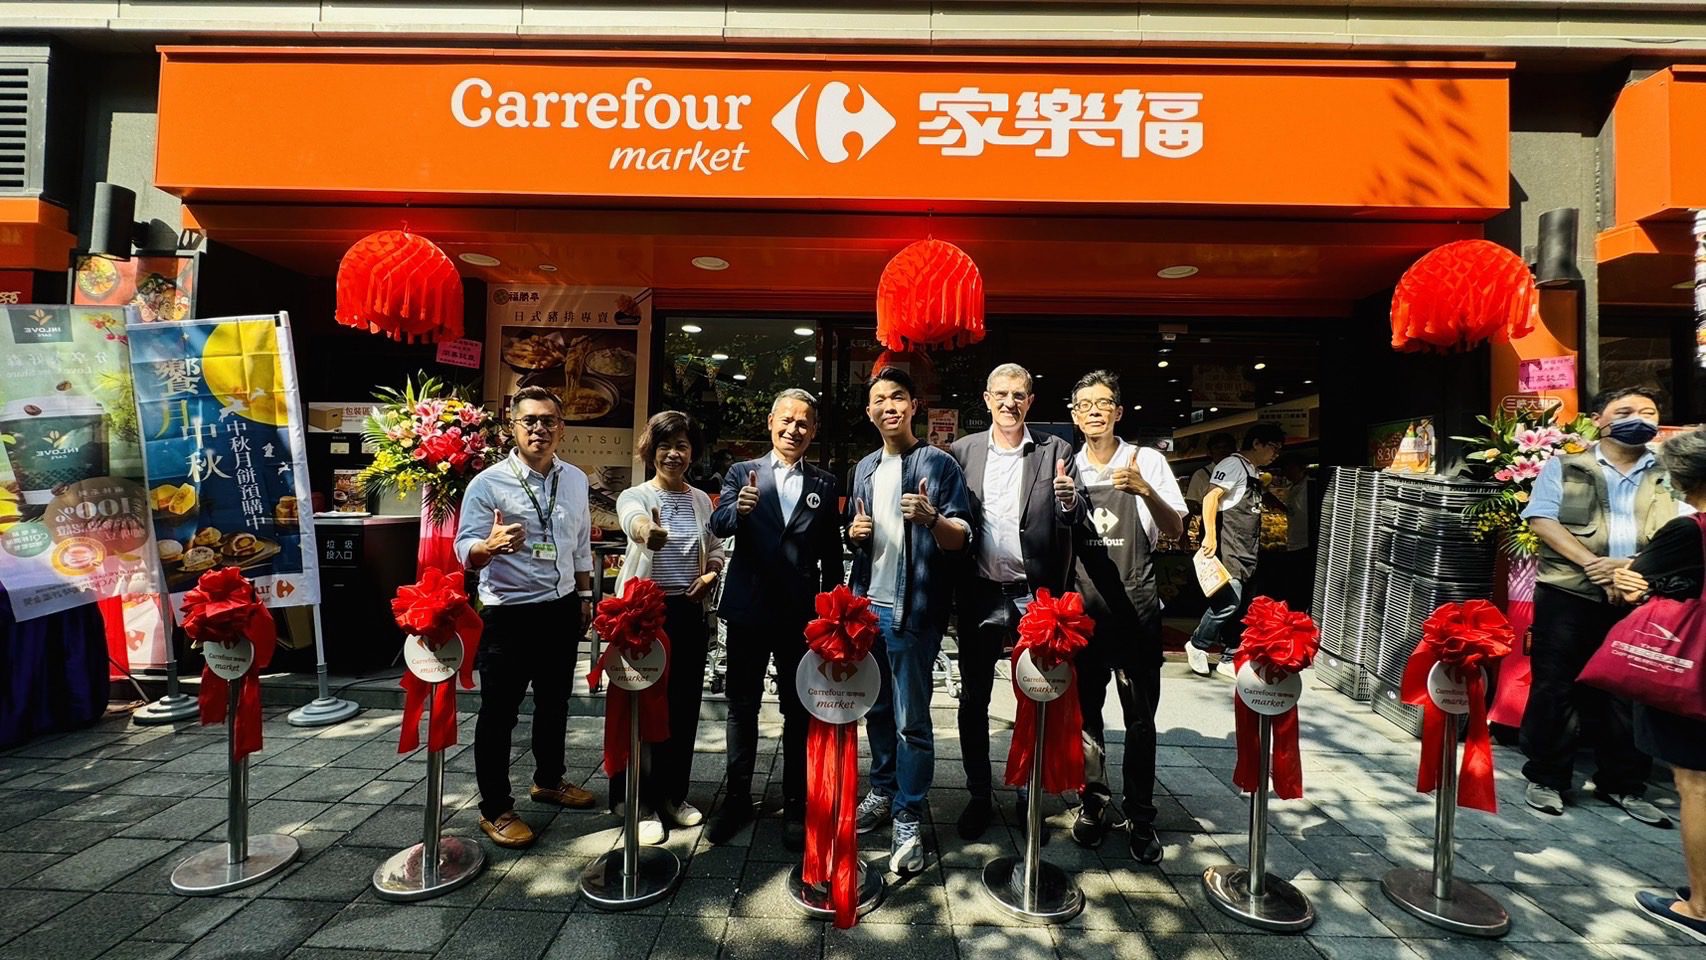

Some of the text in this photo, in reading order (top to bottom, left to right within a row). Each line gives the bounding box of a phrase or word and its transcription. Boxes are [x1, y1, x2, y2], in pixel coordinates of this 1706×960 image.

[451, 77, 752, 131] Carrefour
[918, 87, 1204, 158] 家樂福
[609, 140, 750, 175] market
[226, 419, 266, 530] 中秋月餅預購中
[1213, 470, 1226, 481] 10
[1087, 537, 1124, 546] rrefour
[326, 551, 353, 560] 投入口
[808, 688, 846, 697] Carrefour
[1244, 688, 1276, 697] Carrefour
[816, 700, 856, 710] market
[1251, 698, 1286, 708] market
